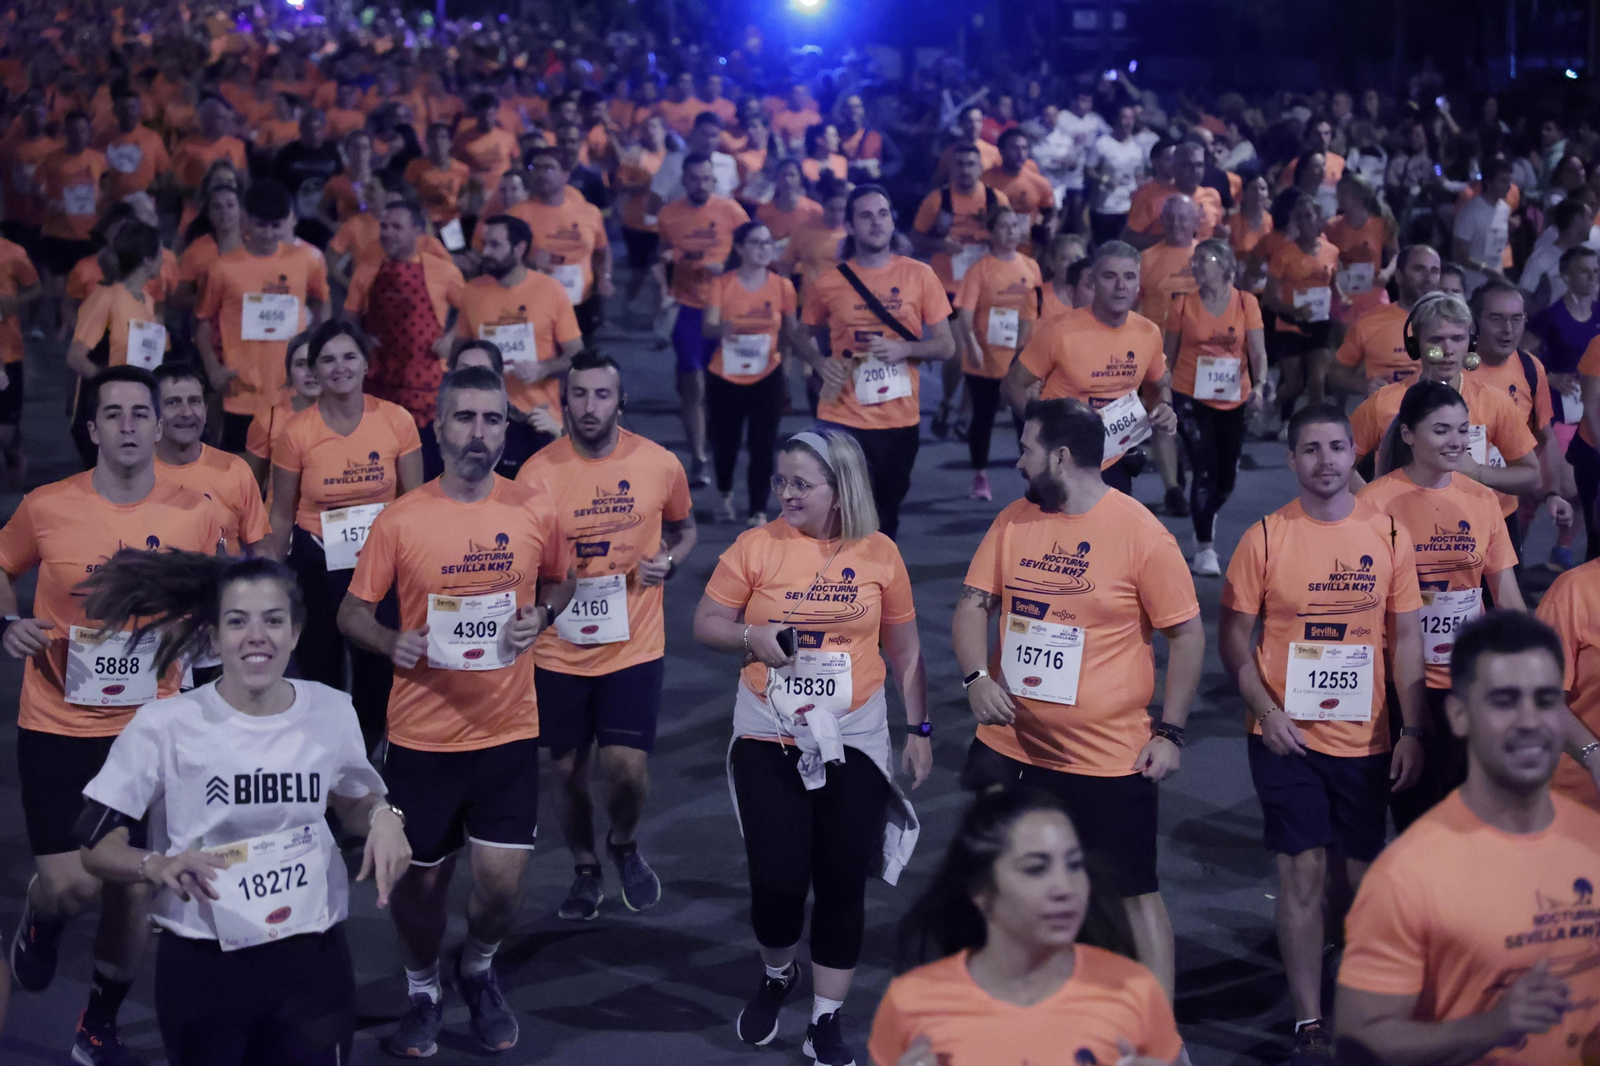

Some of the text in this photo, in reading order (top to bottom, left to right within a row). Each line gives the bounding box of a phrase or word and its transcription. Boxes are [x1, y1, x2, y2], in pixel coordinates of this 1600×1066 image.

[864, 364, 898, 382] 20016
[343, 466, 384, 476] NOCTURNA
[323, 477, 362, 485] SEVILLA
[592, 497, 634, 505] NOCTURNA
[574, 506, 610, 517] SEVILLA
[341, 526, 370, 542] 157
[1413, 544, 1452, 552] EVILLA
[463, 552, 514, 562] NOCTURNA
[1042, 553, 1089, 568] NOCTURNA
[441, 563, 486, 575] SEVILLA
[1019, 558, 1061, 574] SEVILLA
[1328, 573, 1376, 582] NOCTURNA
[810, 585, 858, 593] NOCTURNA
[1308, 583, 1350, 591] SEVILLA
[571, 599, 609, 617] 4160
[454, 621, 497, 638] 4309
[1016, 645, 1064, 670] 15716
[95, 657, 140, 674] 5888
[784, 676, 836, 696] 15830
[1308, 670, 1358, 689] 12553
[234, 768, 320, 804] BÍBELO
[238, 863, 308, 901] 18272
